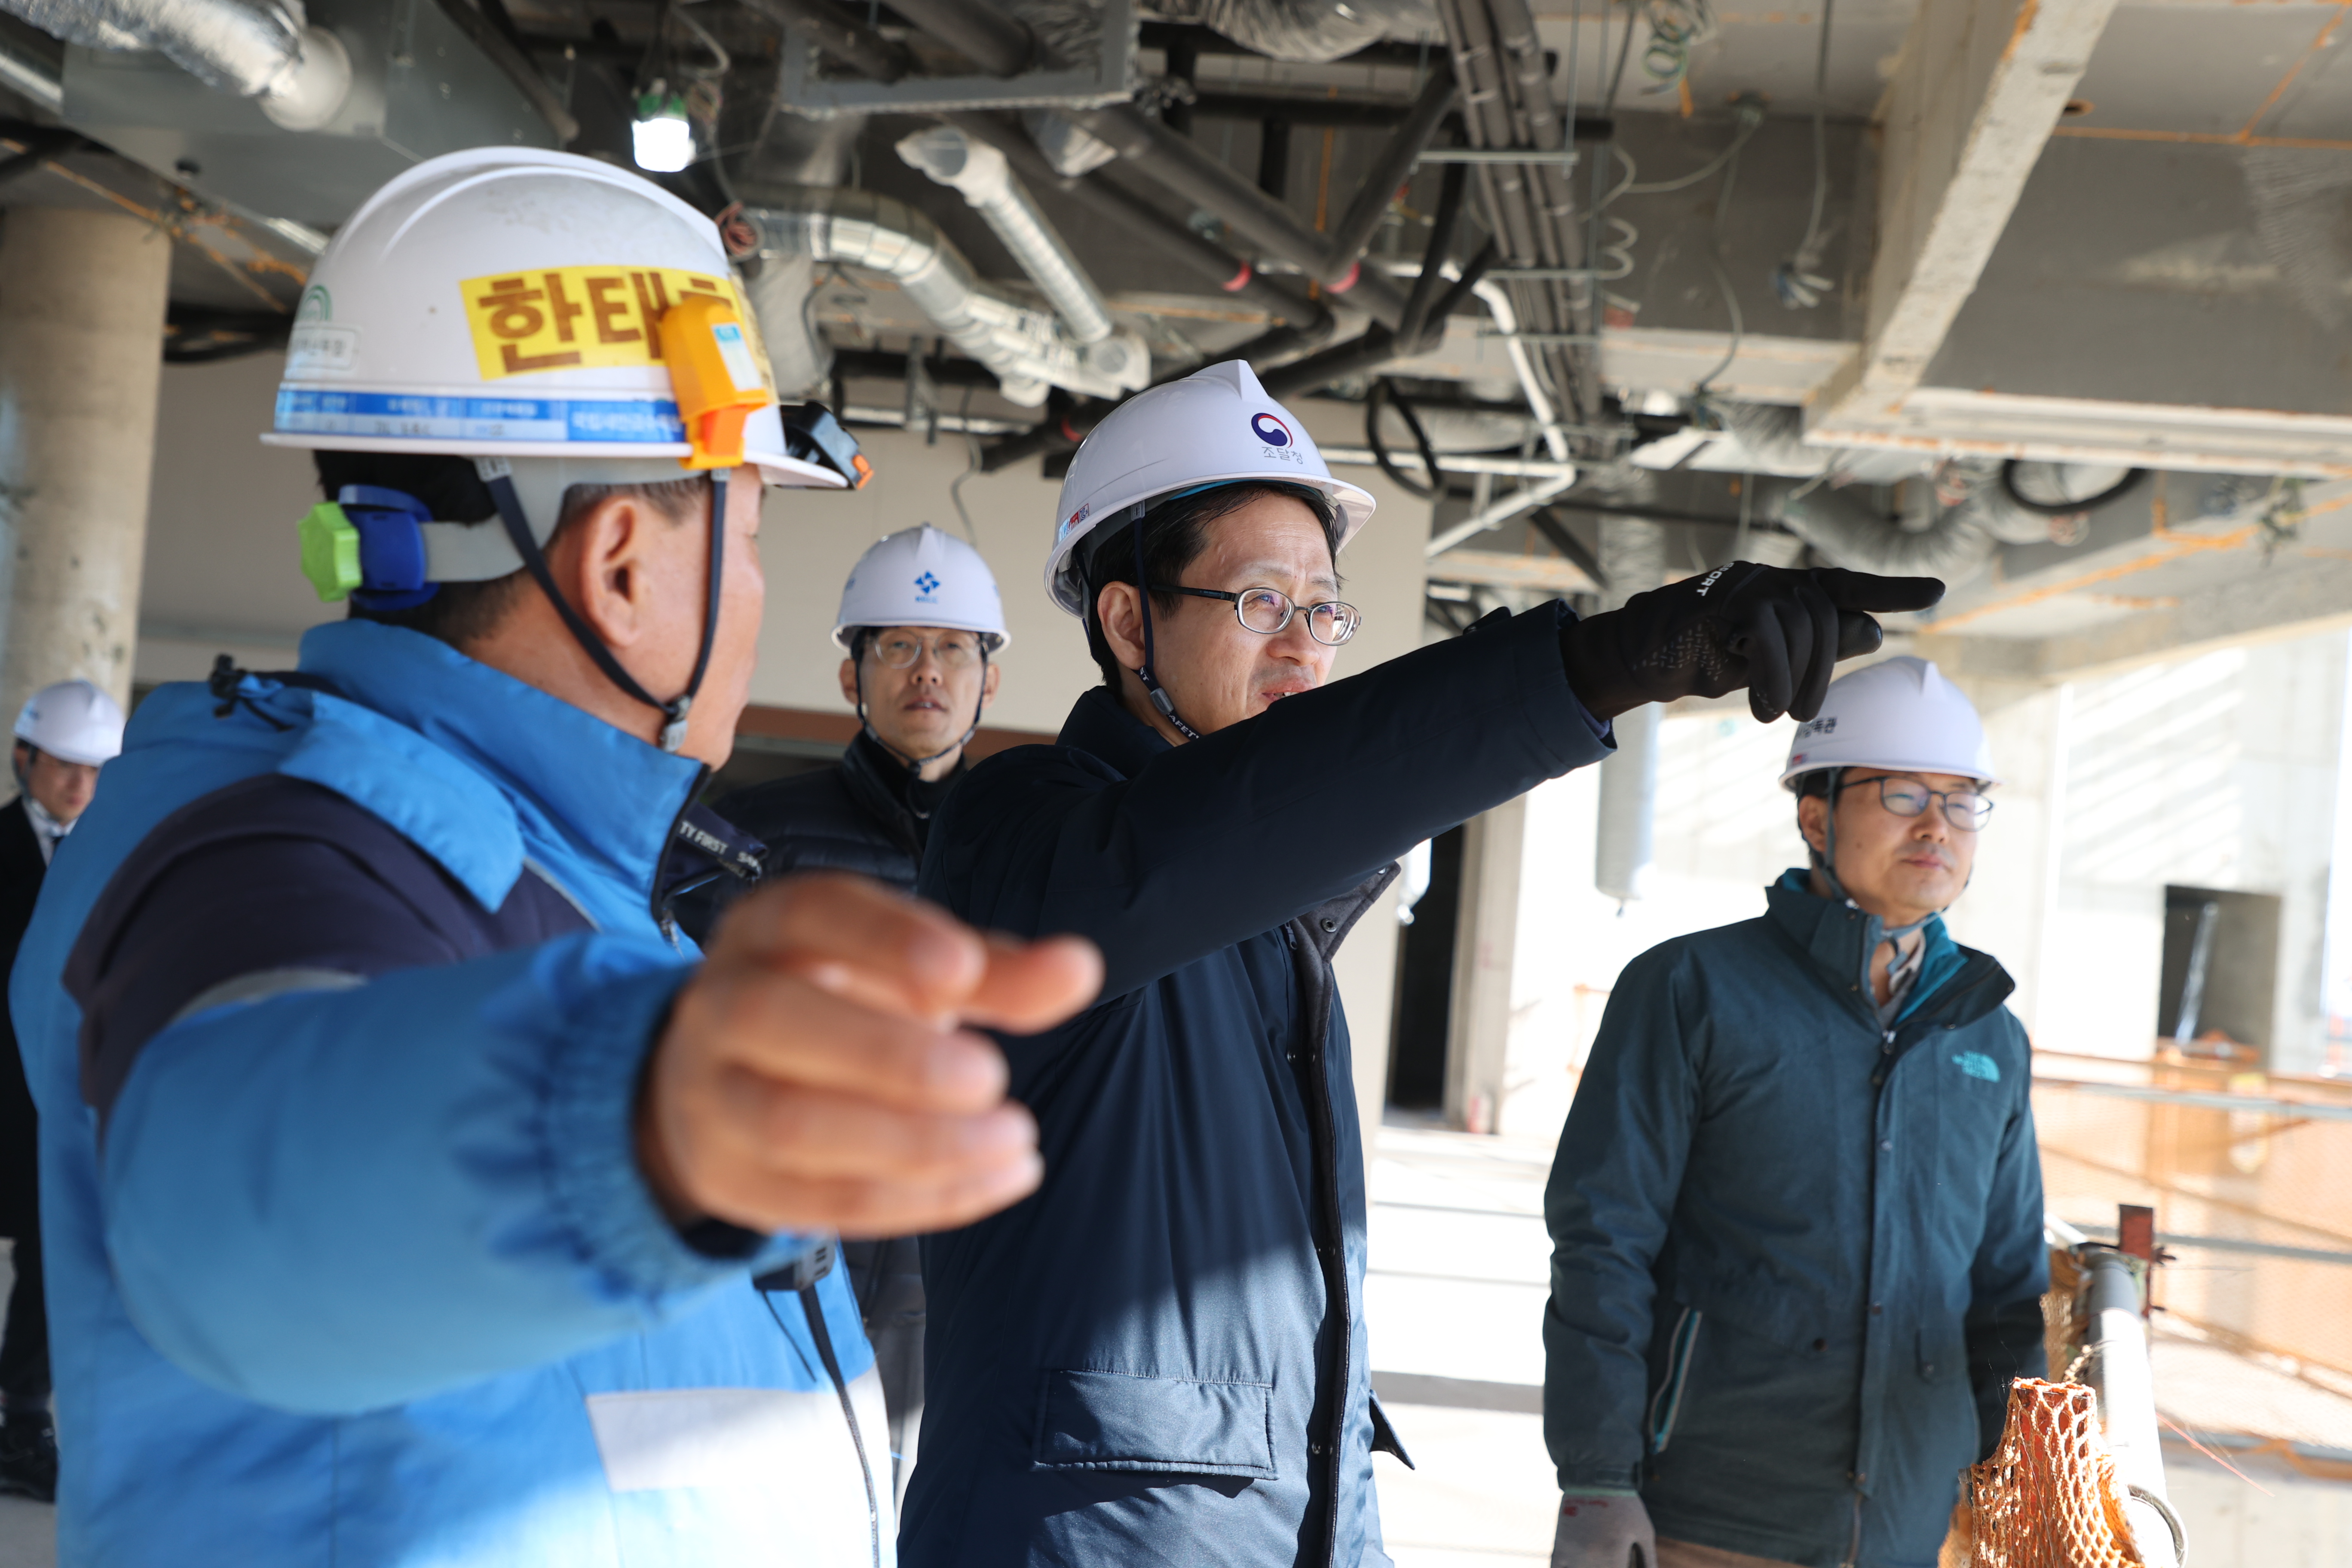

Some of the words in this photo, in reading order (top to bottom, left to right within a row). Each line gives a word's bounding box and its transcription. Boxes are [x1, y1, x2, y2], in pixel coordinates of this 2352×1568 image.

[478, 272, 733, 374] 한태
[1262, 447, 1303, 465] 조달청
[1167, 712, 1200, 739] AFET
[694, 830, 729, 855] FIRST
